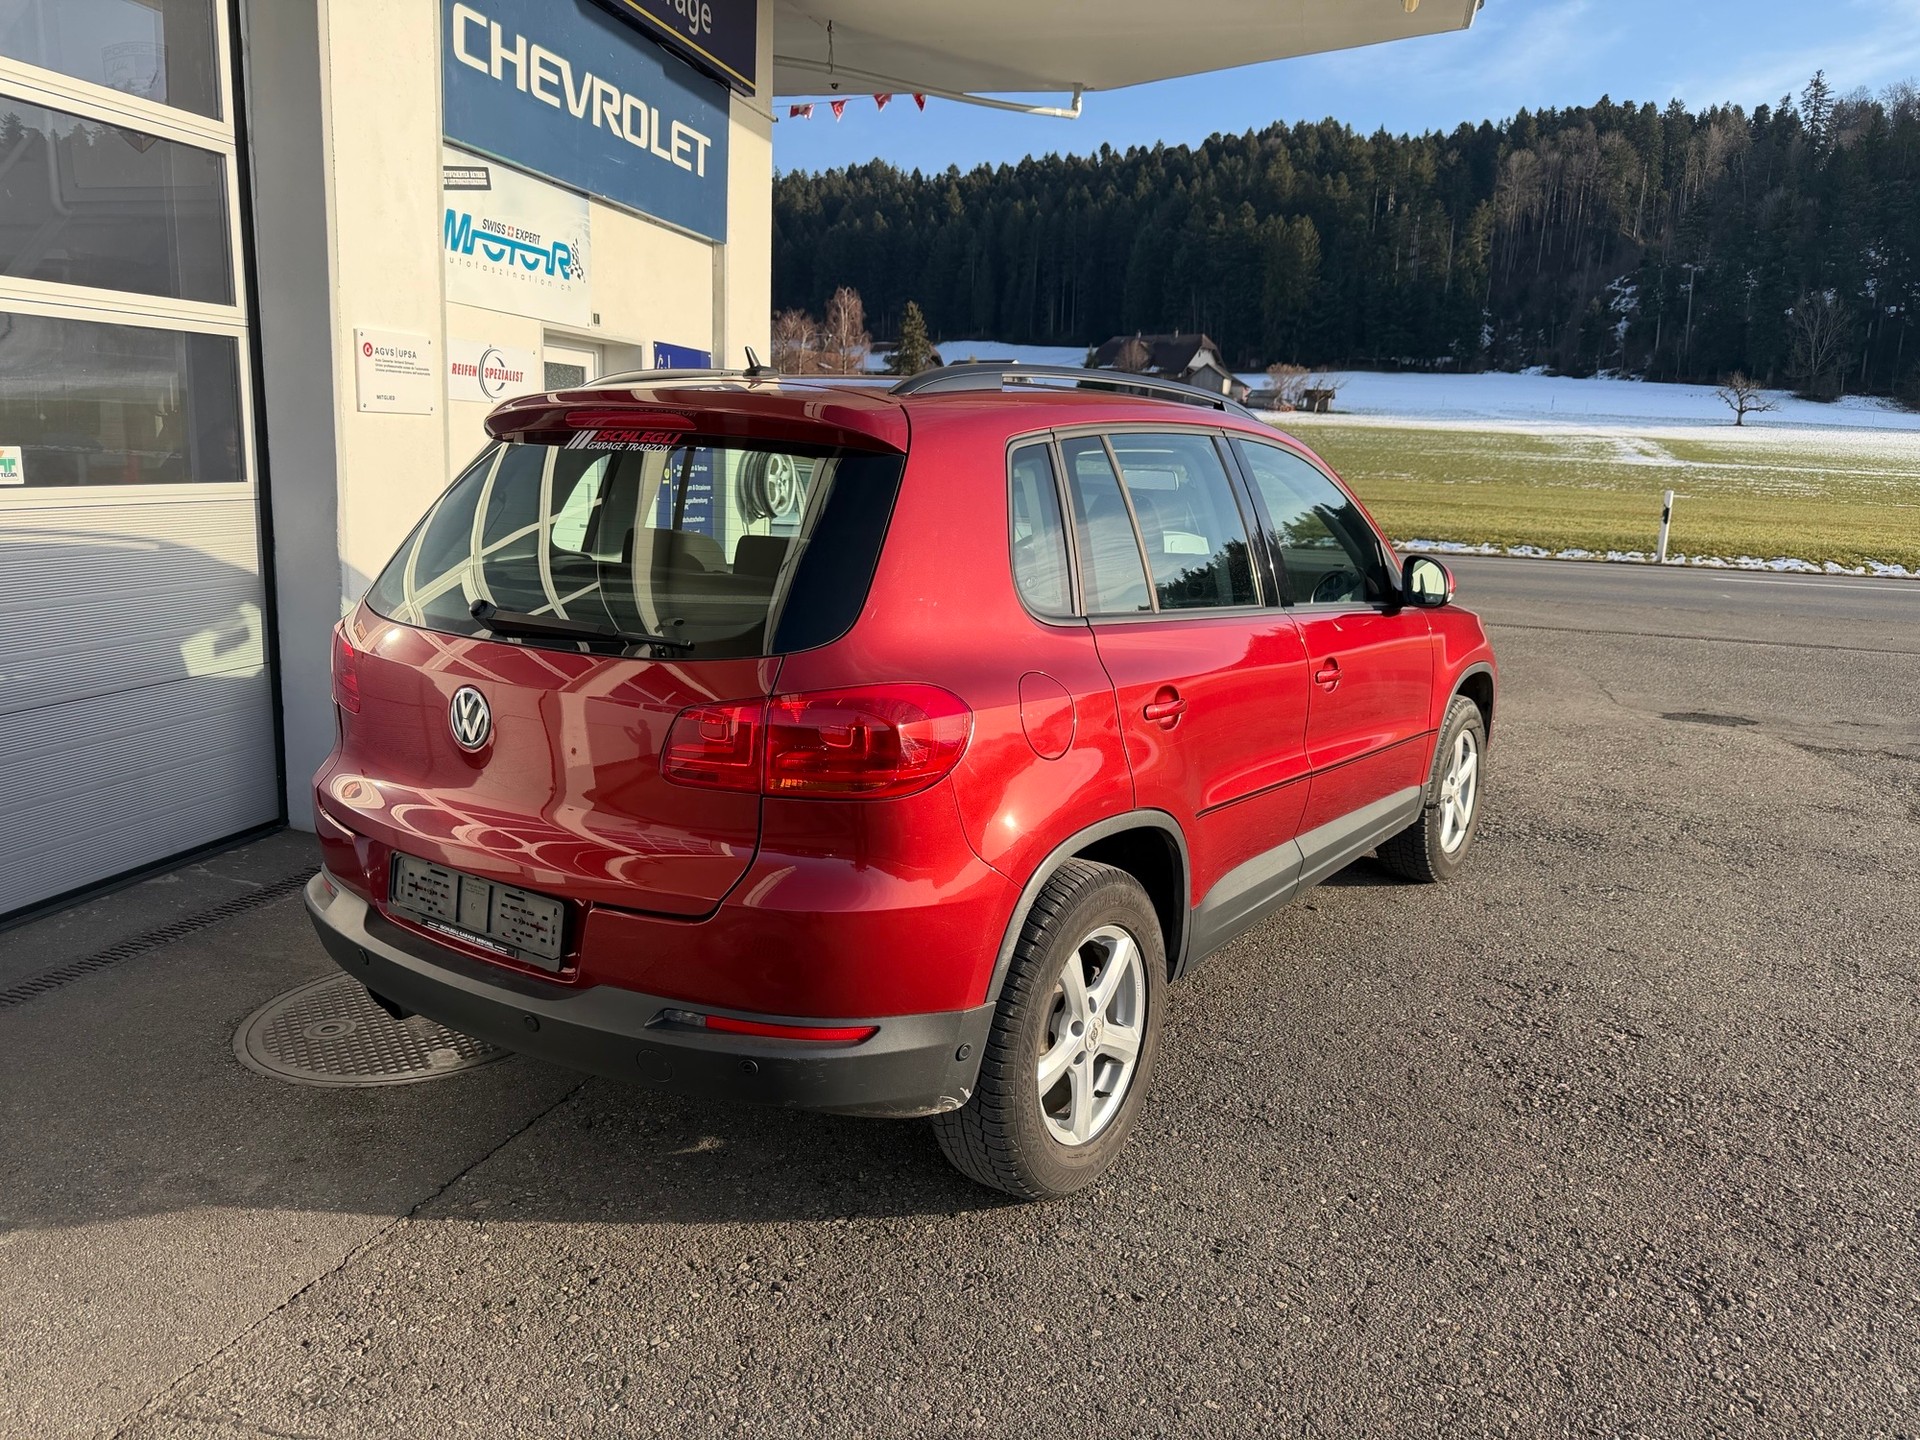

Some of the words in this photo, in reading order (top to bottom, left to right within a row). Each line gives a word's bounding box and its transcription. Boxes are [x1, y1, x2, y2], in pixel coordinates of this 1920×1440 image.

[666, 0, 712, 35] age
[453, 2, 711, 178] CHEVROLET
[482, 219, 506, 235] SWISS
[515, 228, 541, 245] EXPERT
[449, 257, 572, 292] utofaszination.ch
[375, 347, 395, 357] AGVS
[398, 349, 417, 359] UPSA
[452, 363, 477, 377] REIFEN
[484, 367, 524, 382] SPEZIALIST
[586, 441, 626, 451] GARAGE
[626, 442, 672, 453] TRABZON
